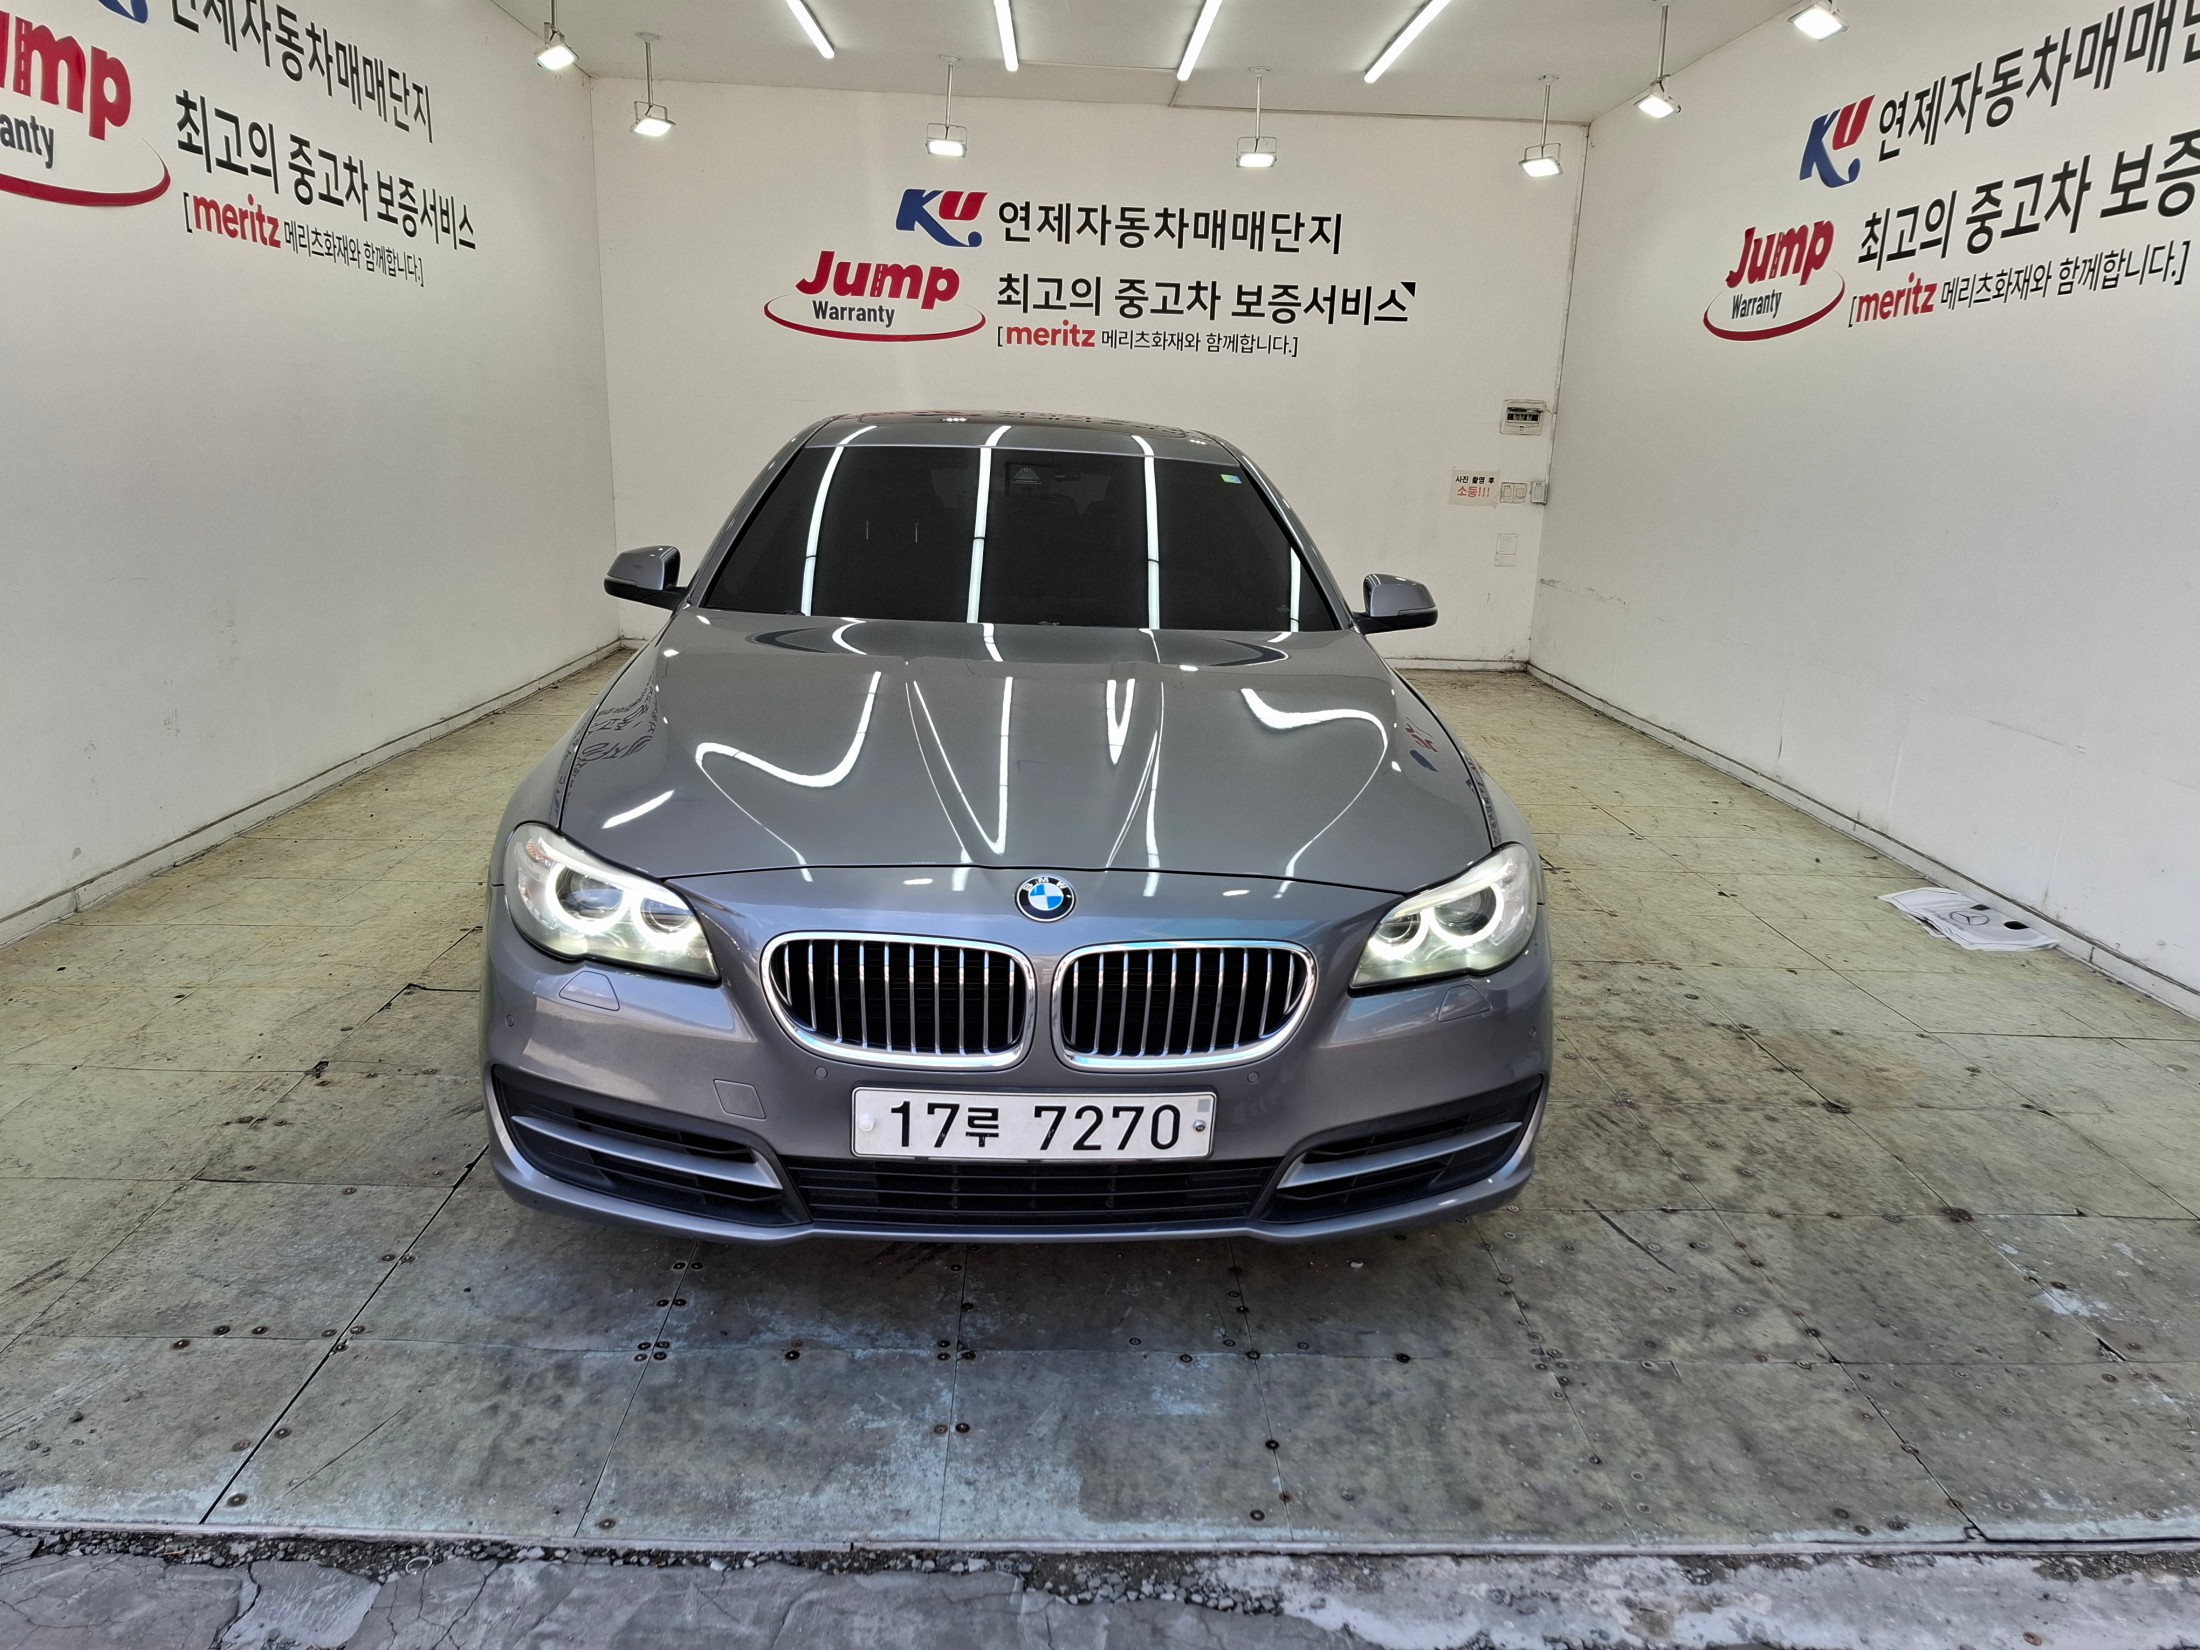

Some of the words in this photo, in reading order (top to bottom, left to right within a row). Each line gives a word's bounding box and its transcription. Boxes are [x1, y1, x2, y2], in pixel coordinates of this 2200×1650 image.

[175, 89, 279, 194] 최고의
[287, 134, 369, 222] 중고차
[376, 170, 477, 250] 보증서비스
[999, 200, 1342, 255] 연제자동차매매단지
[1857, 190, 1957, 272] 최고의
[1964, 154, 2092, 255] 중고차
[284, 221, 361, 269] 메리츠화재와
[363, 241, 424, 287] 함께합니다.]
[795, 250, 960, 309] Jump
[1725, 219, 1835, 288] Jump
[1940, 260, 2053, 311] 메리츠화재와
[2056, 240, 2190, 296] 함께합니다.]
[812, 300, 895, 328] Warranty
[997, 272, 1101, 316] 최고의
[1114, 278, 1222, 321] 중고차
[1231, 281, 1409, 326] 보증서비스
[1731, 289, 1783, 320] Warranty
[1101, 329, 1202, 353] 메리츠화재와
[1205, 332, 1299, 358] 함께합니다.]
[1455, 475, 1470, 484] 사진
[1456, 485, 1491, 498] 소등!!!
[1022, 876, 1068, 892] BMW
[890, 1100, 999, 1149] 17루
[1033, 1103, 1181, 1151] 7270
